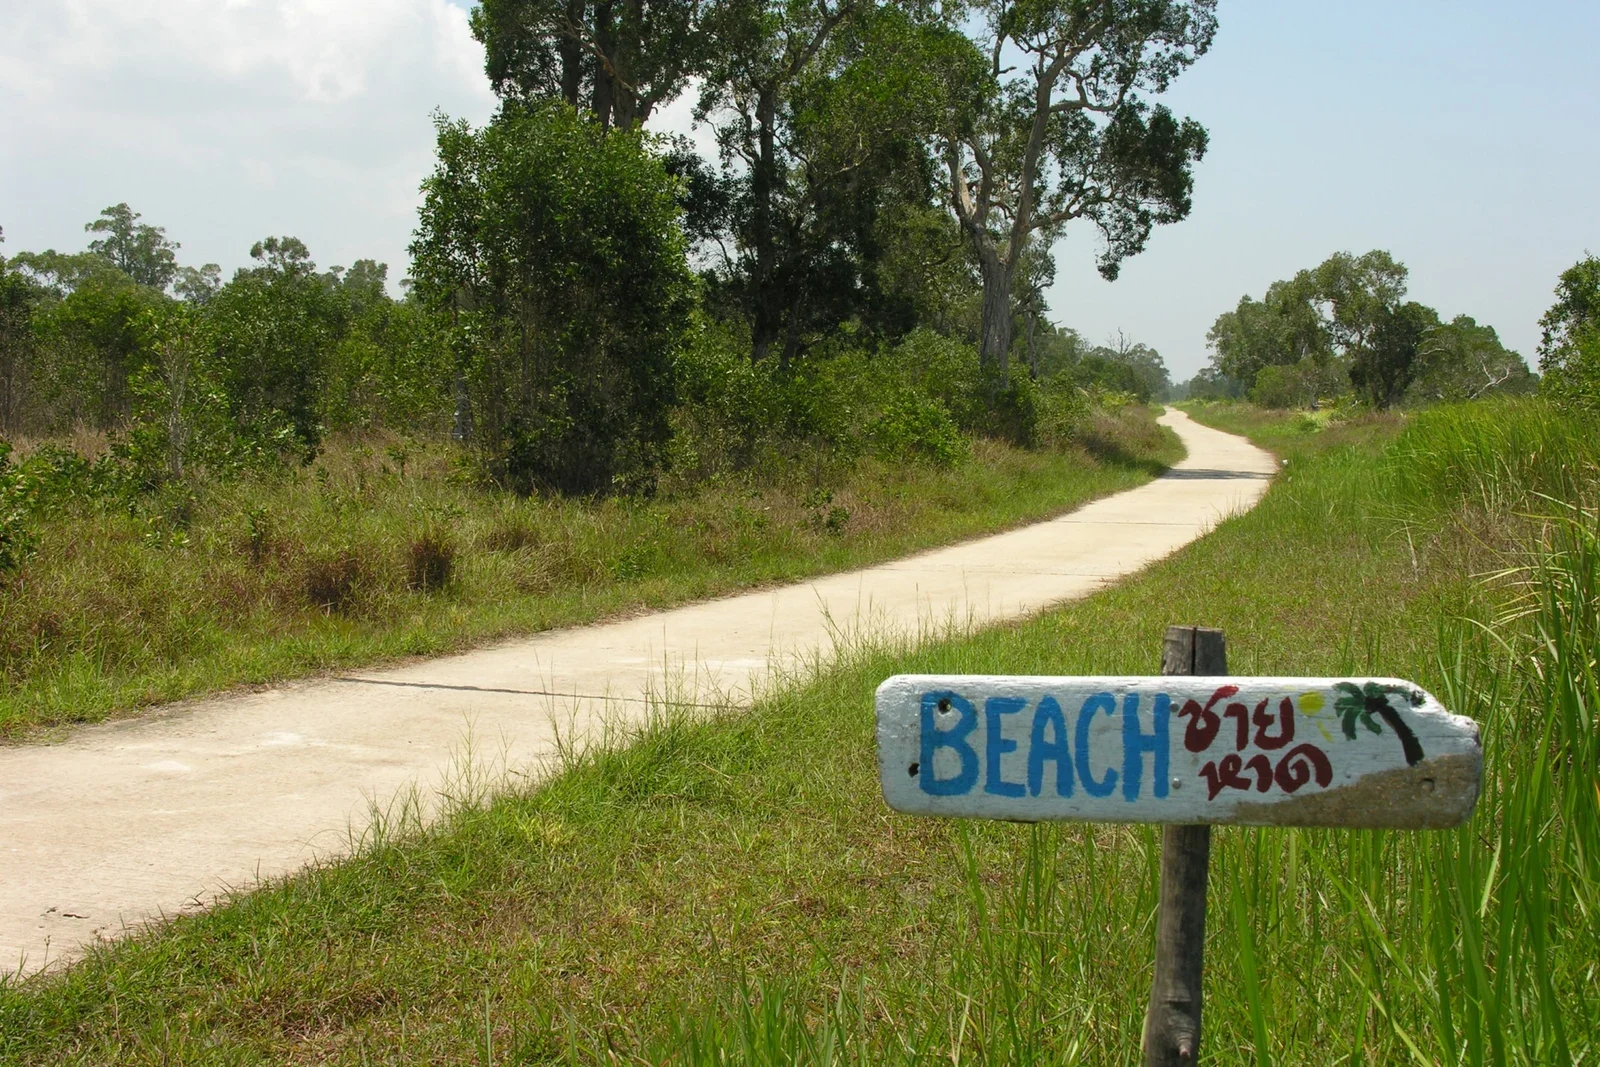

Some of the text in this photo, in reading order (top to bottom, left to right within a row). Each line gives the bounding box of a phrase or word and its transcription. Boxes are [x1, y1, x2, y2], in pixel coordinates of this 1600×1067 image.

[919, 690, 1171, 802] BEACH
[1178, 685, 1295, 752] ชาย
[1198, 743, 1333, 801] หาด
